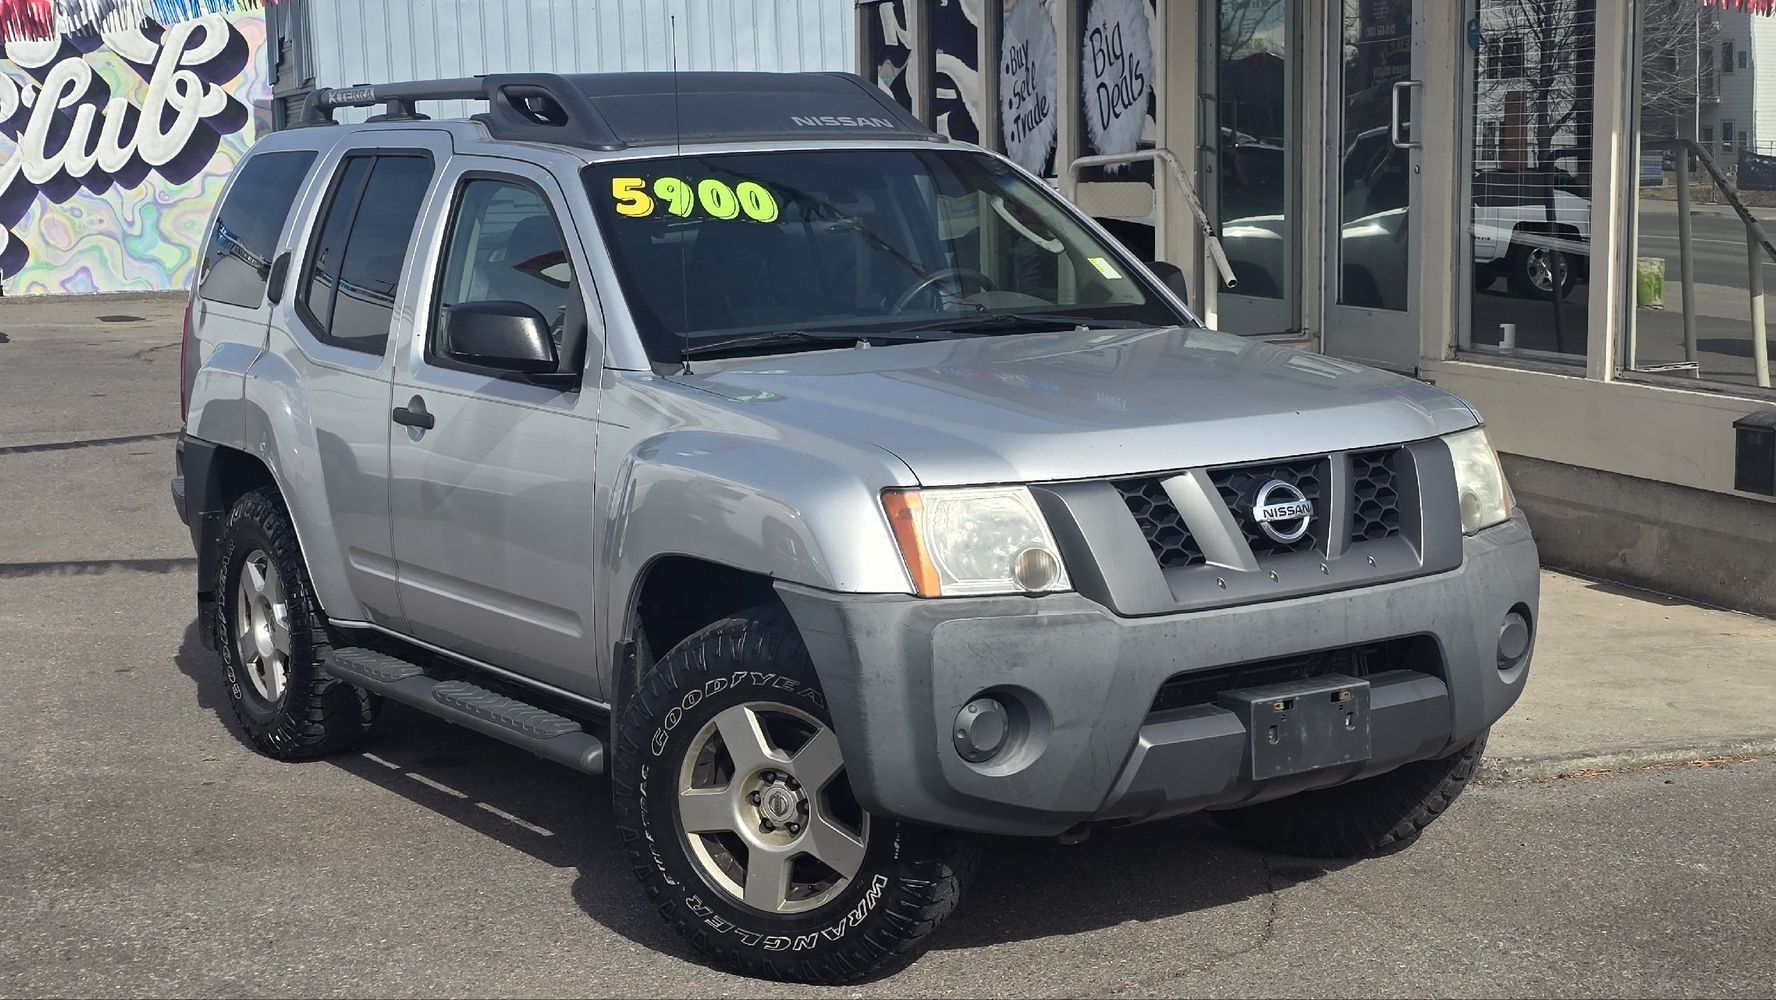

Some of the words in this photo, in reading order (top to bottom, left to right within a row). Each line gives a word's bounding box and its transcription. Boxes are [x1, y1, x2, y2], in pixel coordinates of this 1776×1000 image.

[1010, 40, 1029, 77] Buy
[1089, 20, 1124, 79] Big
[1013, 61, 1037, 110] Sell
[1096, 52, 1146, 131] Deals
[790, 115, 895, 129] NISSAN
[1013, 92, 1050, 144] Trade
[612, 177, 779, 223] 5900
[1263, 504, 1310, 518] NISSAN
[651, 671, 825, 756] GOODYEA
[685, 874, 888, 951] WRANGLER
